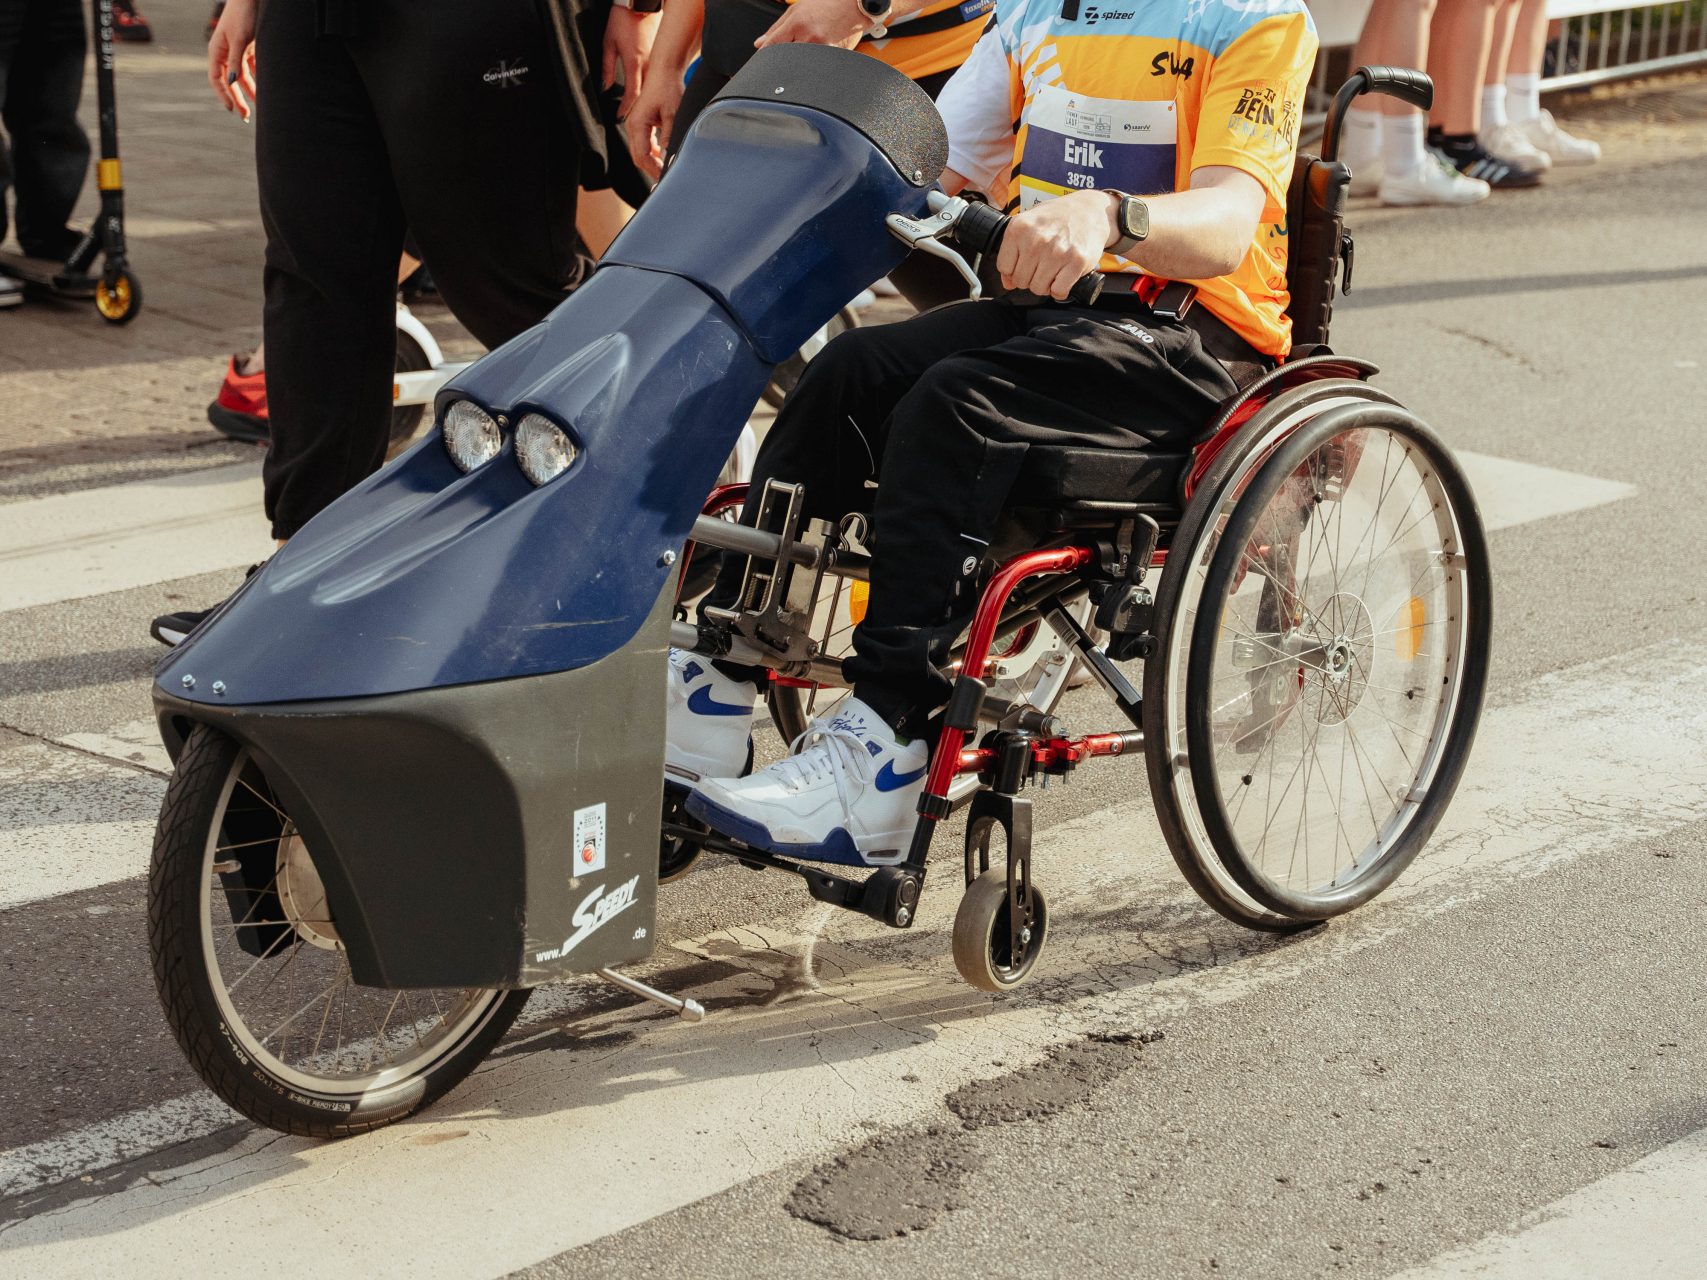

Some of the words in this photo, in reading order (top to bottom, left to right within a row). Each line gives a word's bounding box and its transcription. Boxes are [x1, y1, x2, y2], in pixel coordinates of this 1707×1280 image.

[1101, 9, 1136, 21] spized
[1064, 137, 1104, 169] Erik
[1066, 171, 1095, 189] 3878
[1119, 323, 1155, 345] JAKO
[535, 947, 563, 963] www.
[631, 926, 648, 941] .de
